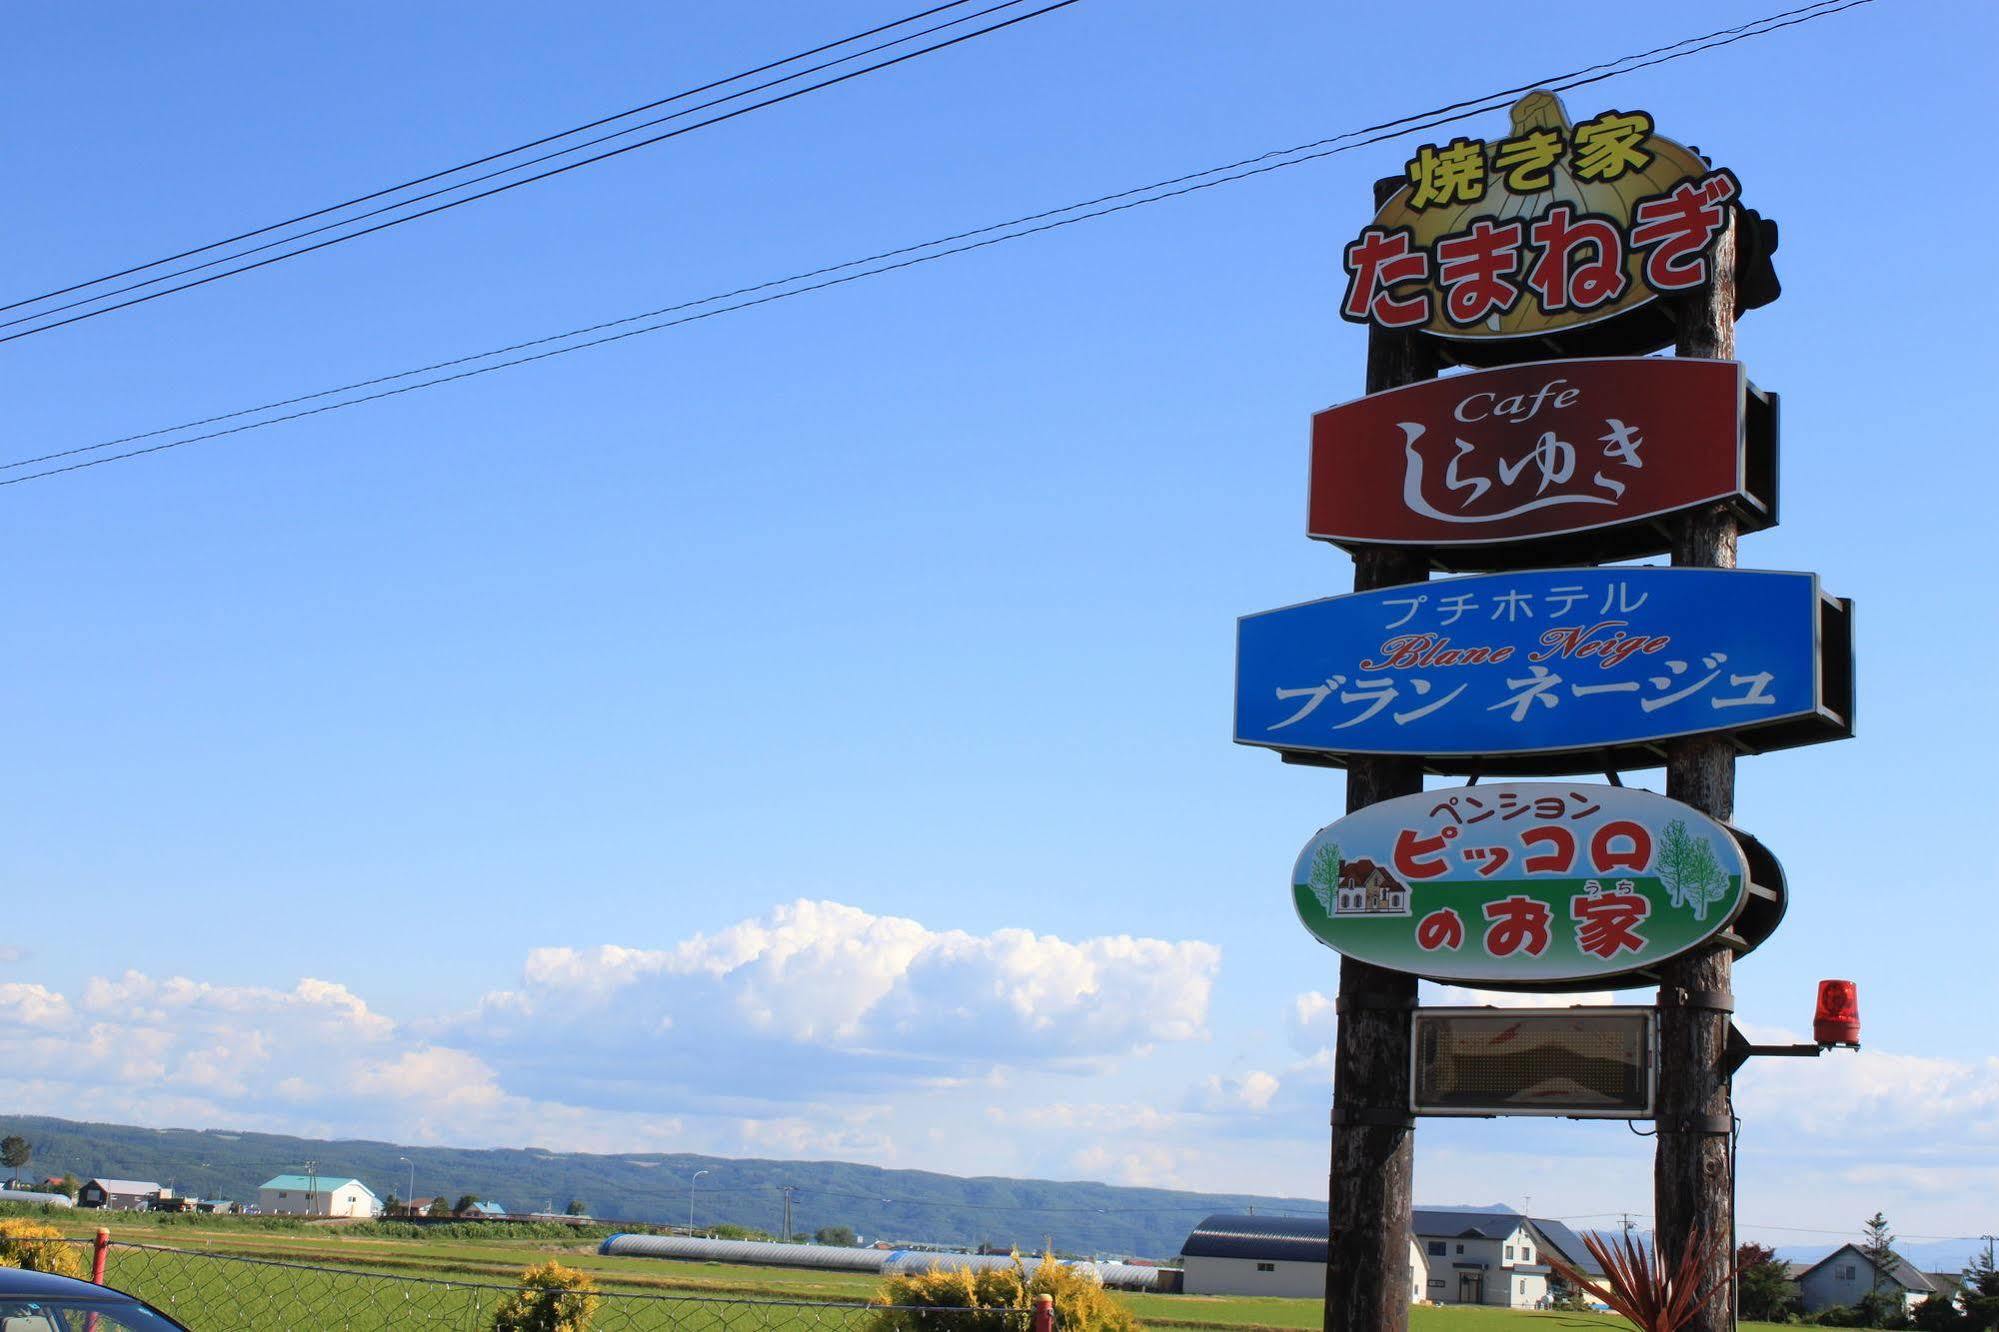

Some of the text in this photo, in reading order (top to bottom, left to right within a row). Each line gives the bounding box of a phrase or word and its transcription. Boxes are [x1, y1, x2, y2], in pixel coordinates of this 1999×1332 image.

[1407, 115, 1653, 210] 焼き家
[1347, 174, 1737, 327] たまねぎ
[1454, 379, 1580, 424] Cafe
[1396, 418, 1644, 524] しらゆき
[1382, 582, 1648, 630] プチホテル
[1528, 621, 1670, 669] Neige
[1266, 652, 1776, 731] ブラン ネージュ
[1429, 792, 1601, 825] ペンション
[1394, 820, 1652, 879] ピッコロ
[1584, 880, 1634, 896] うち
[1417, 893, 1649, 959] のお家
